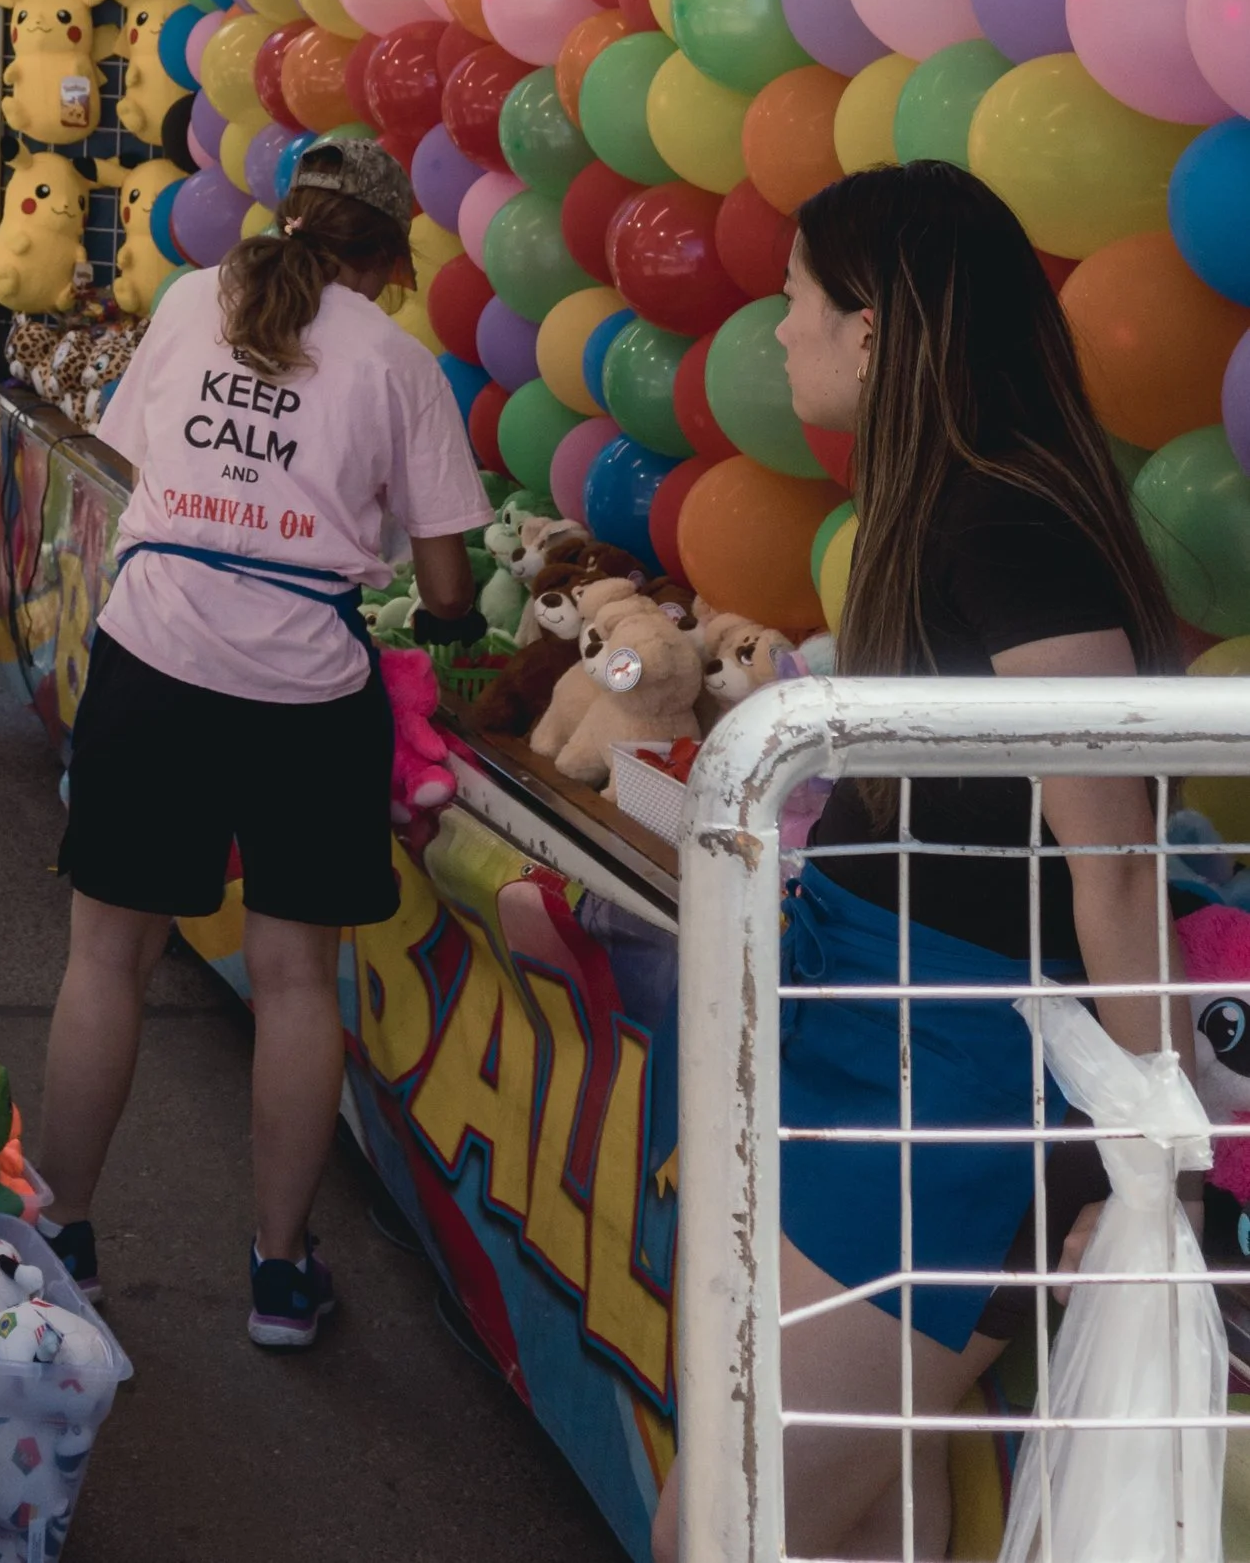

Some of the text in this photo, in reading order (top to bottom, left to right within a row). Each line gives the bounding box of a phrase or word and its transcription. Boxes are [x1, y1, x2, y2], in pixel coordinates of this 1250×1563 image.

[200, 370, 301, 420] KEEP
[184, 414, 299, 472] CALM
[220, 464, 259, 484] AND
[163, 489, 315, 540] CARNIVAL ON
[353, 838, 675, 1406] BALL
